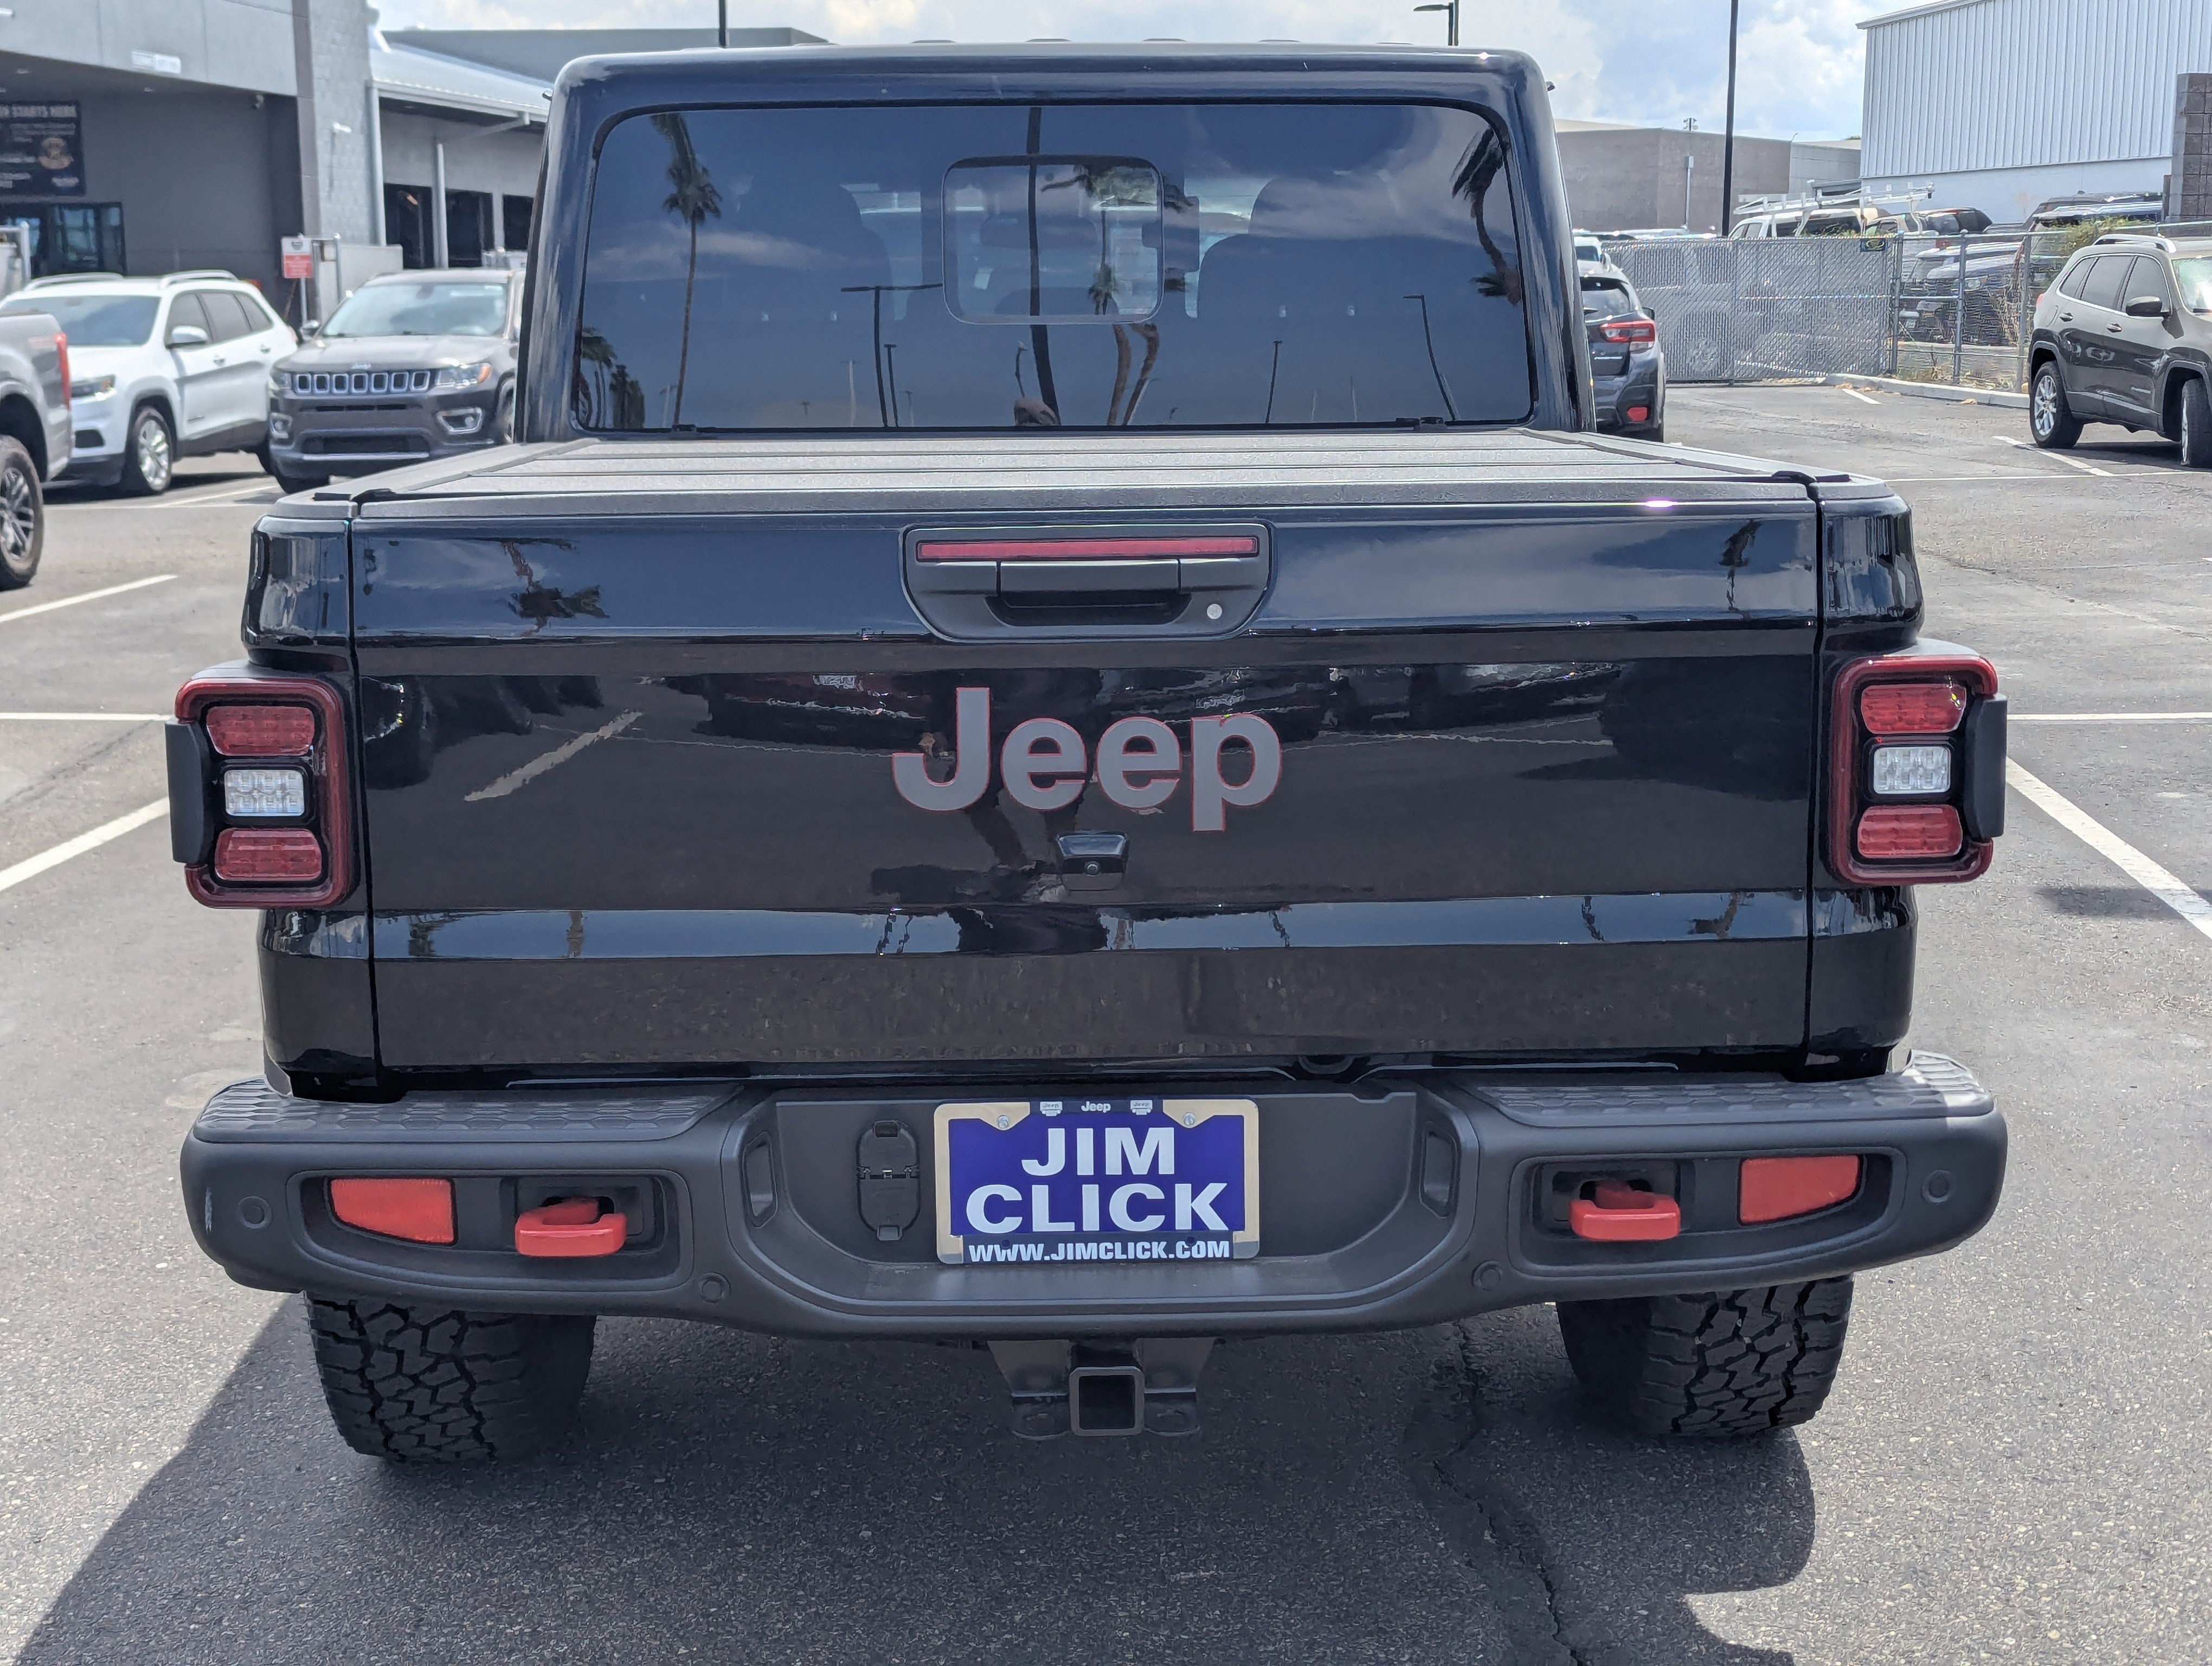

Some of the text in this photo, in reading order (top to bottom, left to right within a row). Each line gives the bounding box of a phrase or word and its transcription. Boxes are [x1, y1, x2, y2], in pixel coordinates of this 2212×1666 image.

[892, 687, 1282, 832] Jeep
[1081, 1101, 1111, 1113] Jeep
[1021, 1127, 1175, 1176] JIM
[966, 1182, 1229, 1234] CLICK
[968, 1240, 1230, 1262] WWW.JIMCLICK.COM
